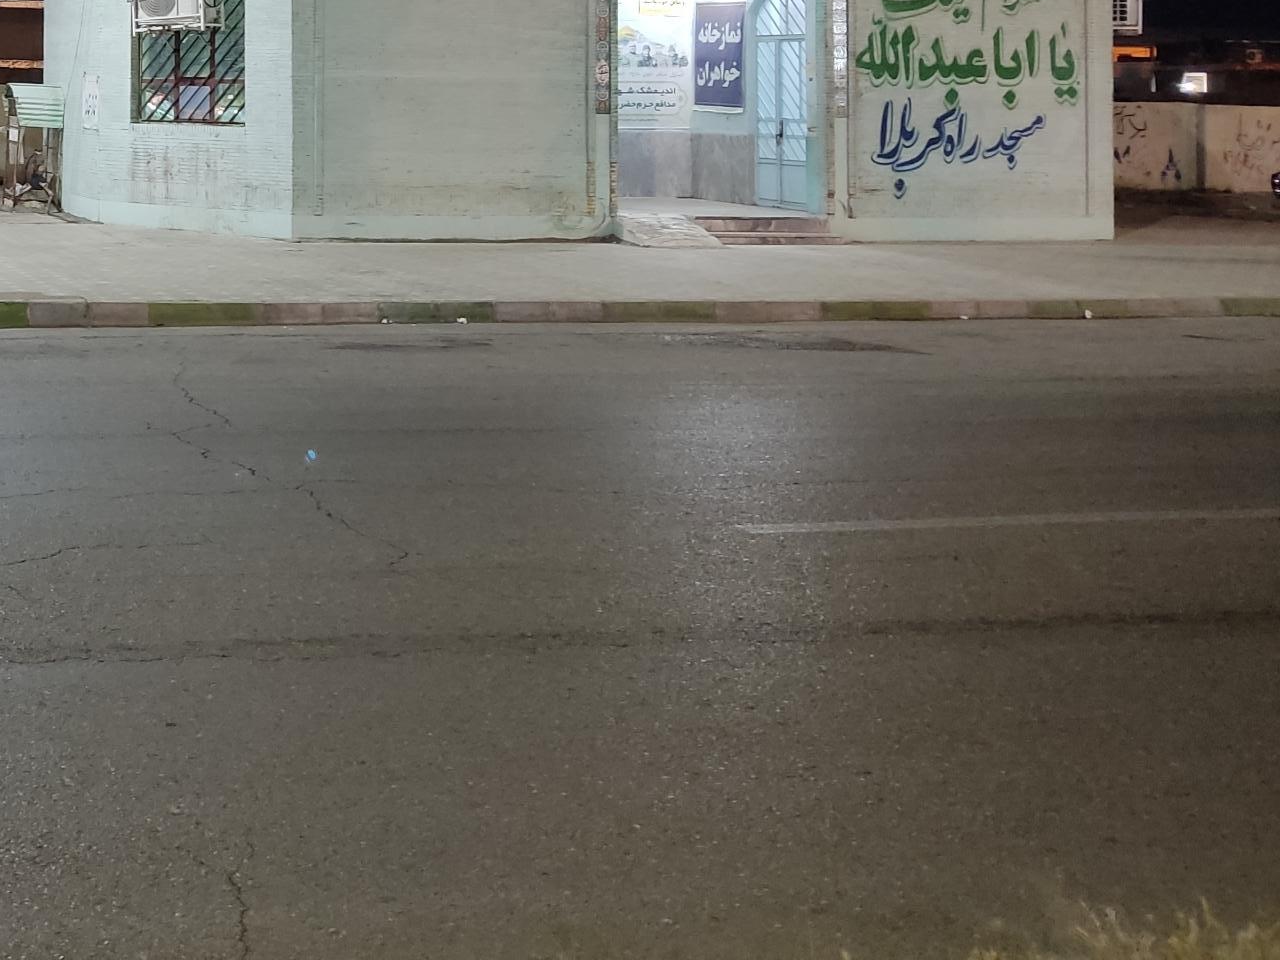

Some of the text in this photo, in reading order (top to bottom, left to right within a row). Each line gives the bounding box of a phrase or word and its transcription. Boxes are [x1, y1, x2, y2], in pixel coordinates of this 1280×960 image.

[697, 21, 742, 51] نمازخانه
[696, 60, 741, 89] خواهران
[983, 114, 1046, 167] مسجد
